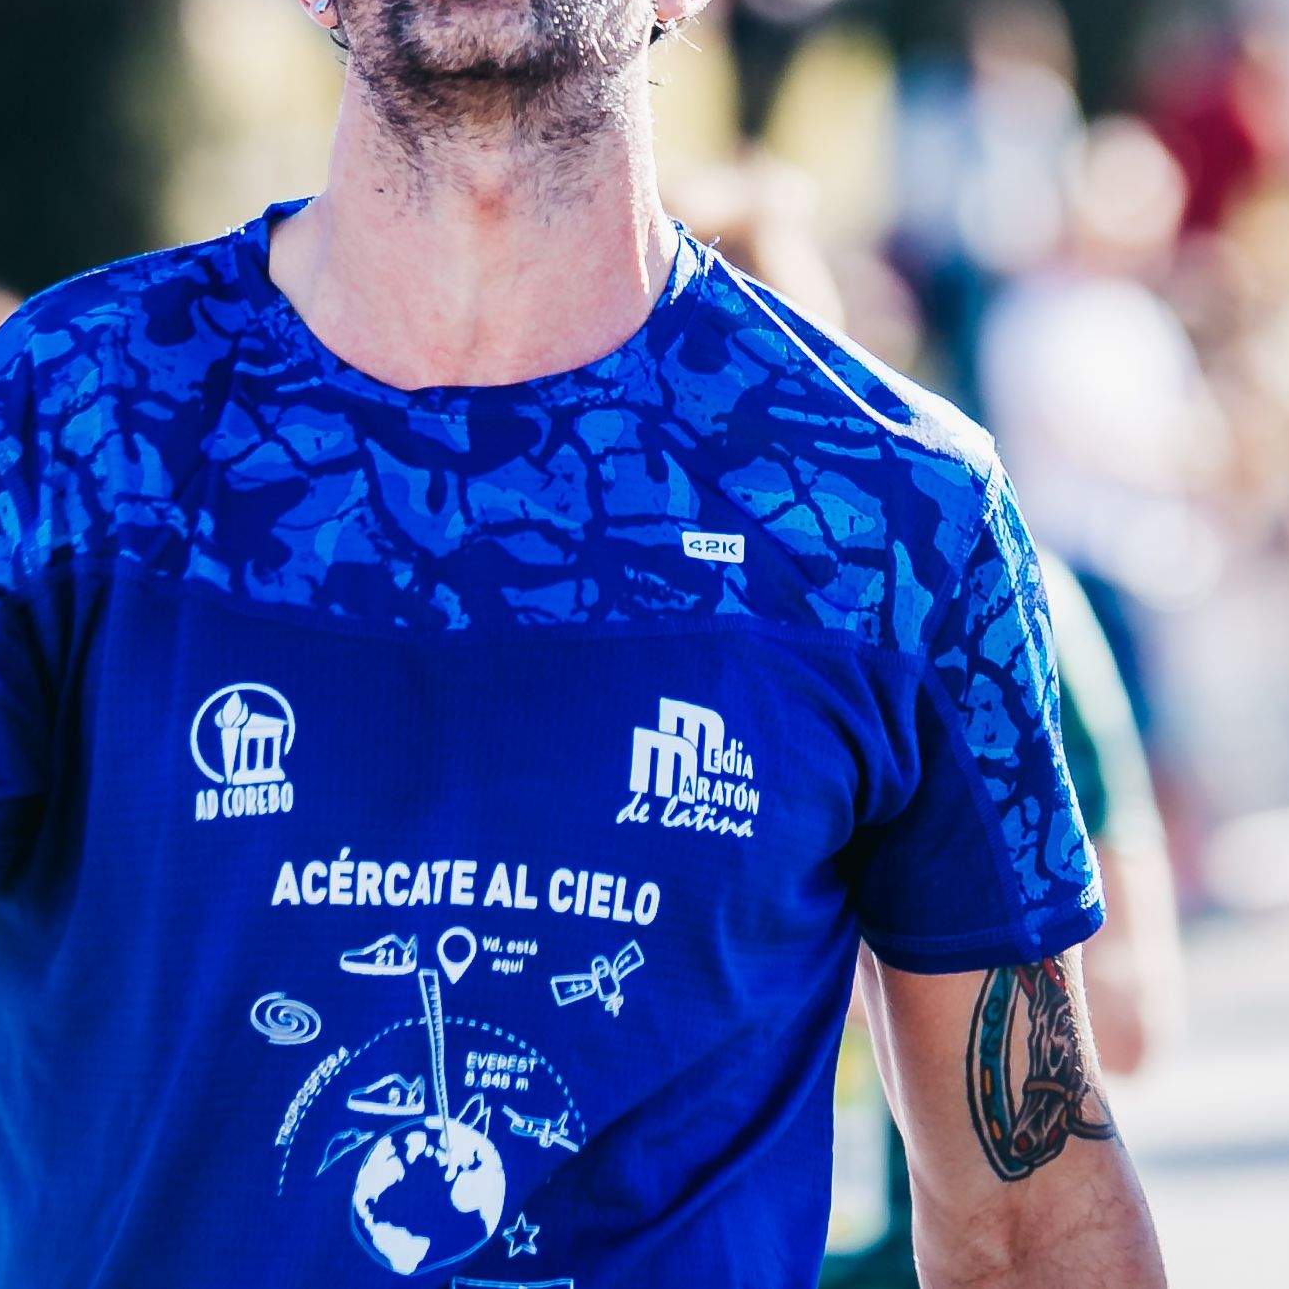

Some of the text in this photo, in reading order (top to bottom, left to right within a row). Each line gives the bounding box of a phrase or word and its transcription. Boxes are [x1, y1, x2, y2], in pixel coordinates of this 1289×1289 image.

[689, 539, 738, 556] 42K
[195, 781, 294, 822] AD COREBO
[616, 792, 650, 824] de
[271, 846, 661, 926] ACÉRCATE AL CIELO
[466, 1051, 539, 1073] EVEREST
[515, 1077, 529, 1091] m
